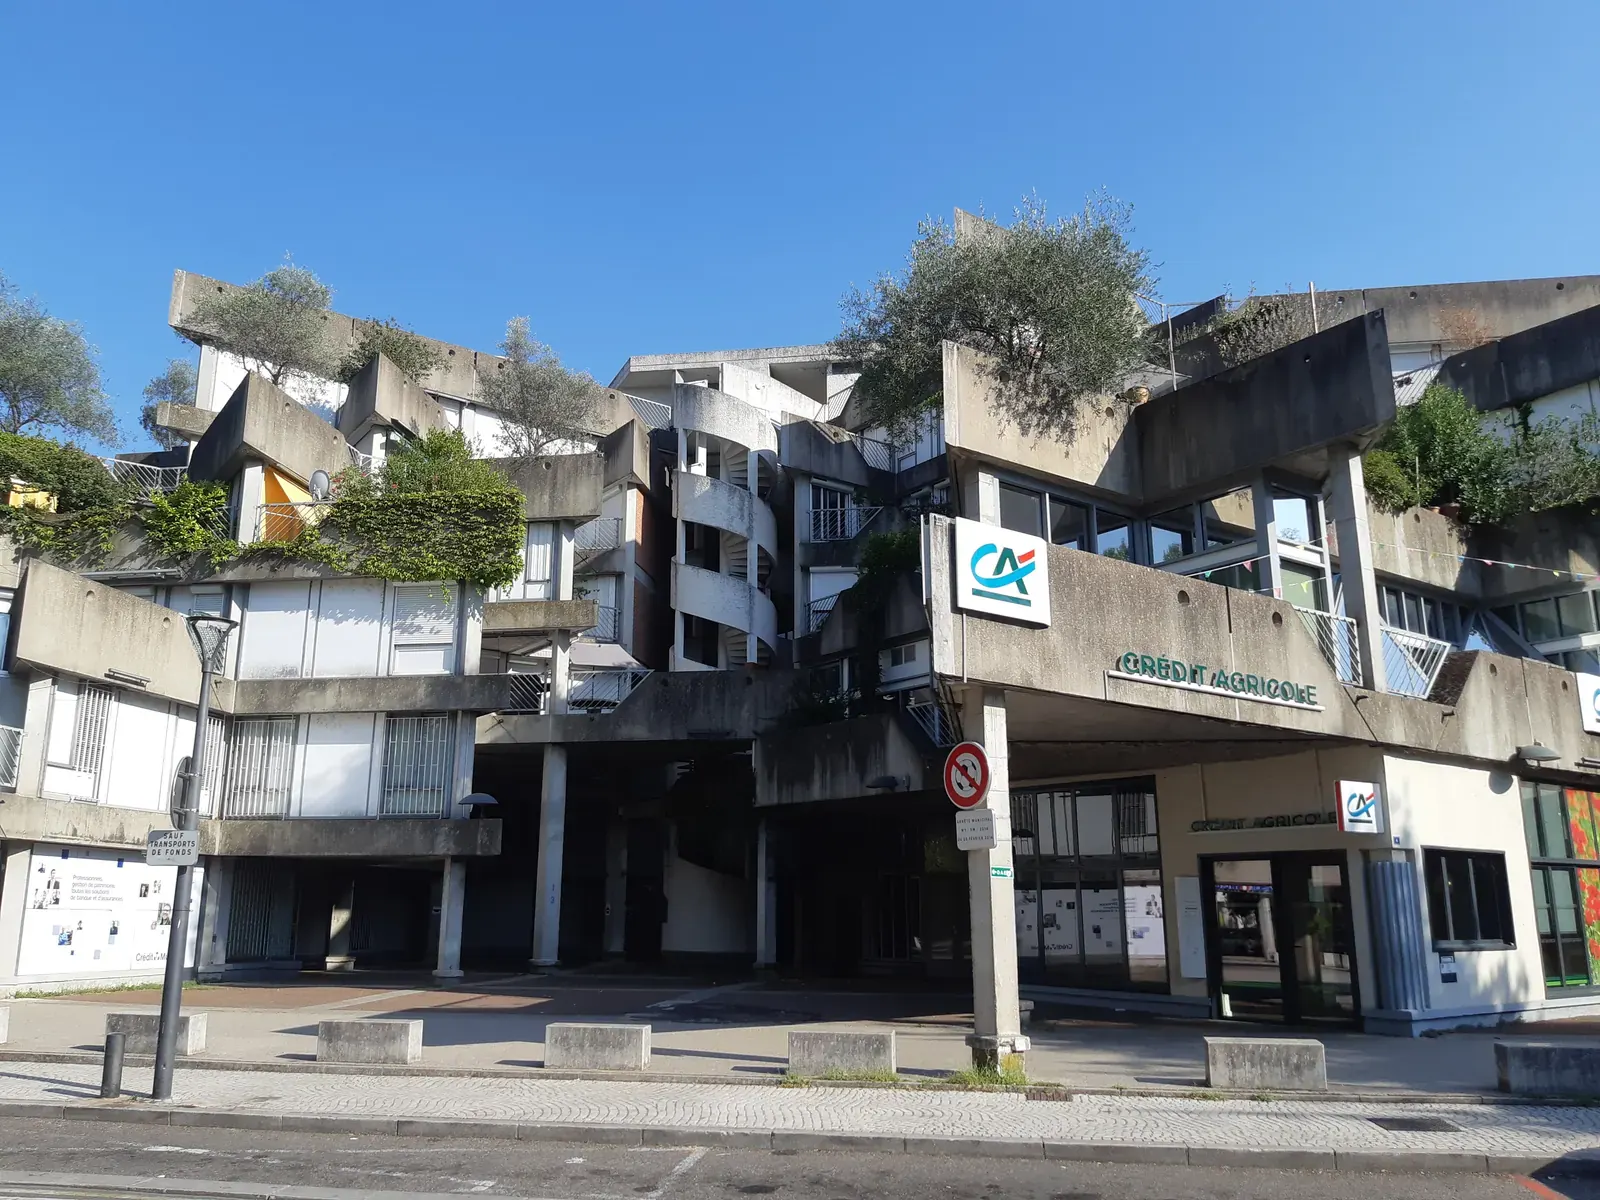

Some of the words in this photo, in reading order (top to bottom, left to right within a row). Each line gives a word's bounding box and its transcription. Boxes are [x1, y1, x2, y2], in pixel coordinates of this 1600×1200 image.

[1121, 651, 1208, 686] CRÉDIT
[1213, 668, 1318, 705] AGRICOLE
[150, 840, 196, 848] TRANSPORTS
[136, 952, 154, 962] Crédit
